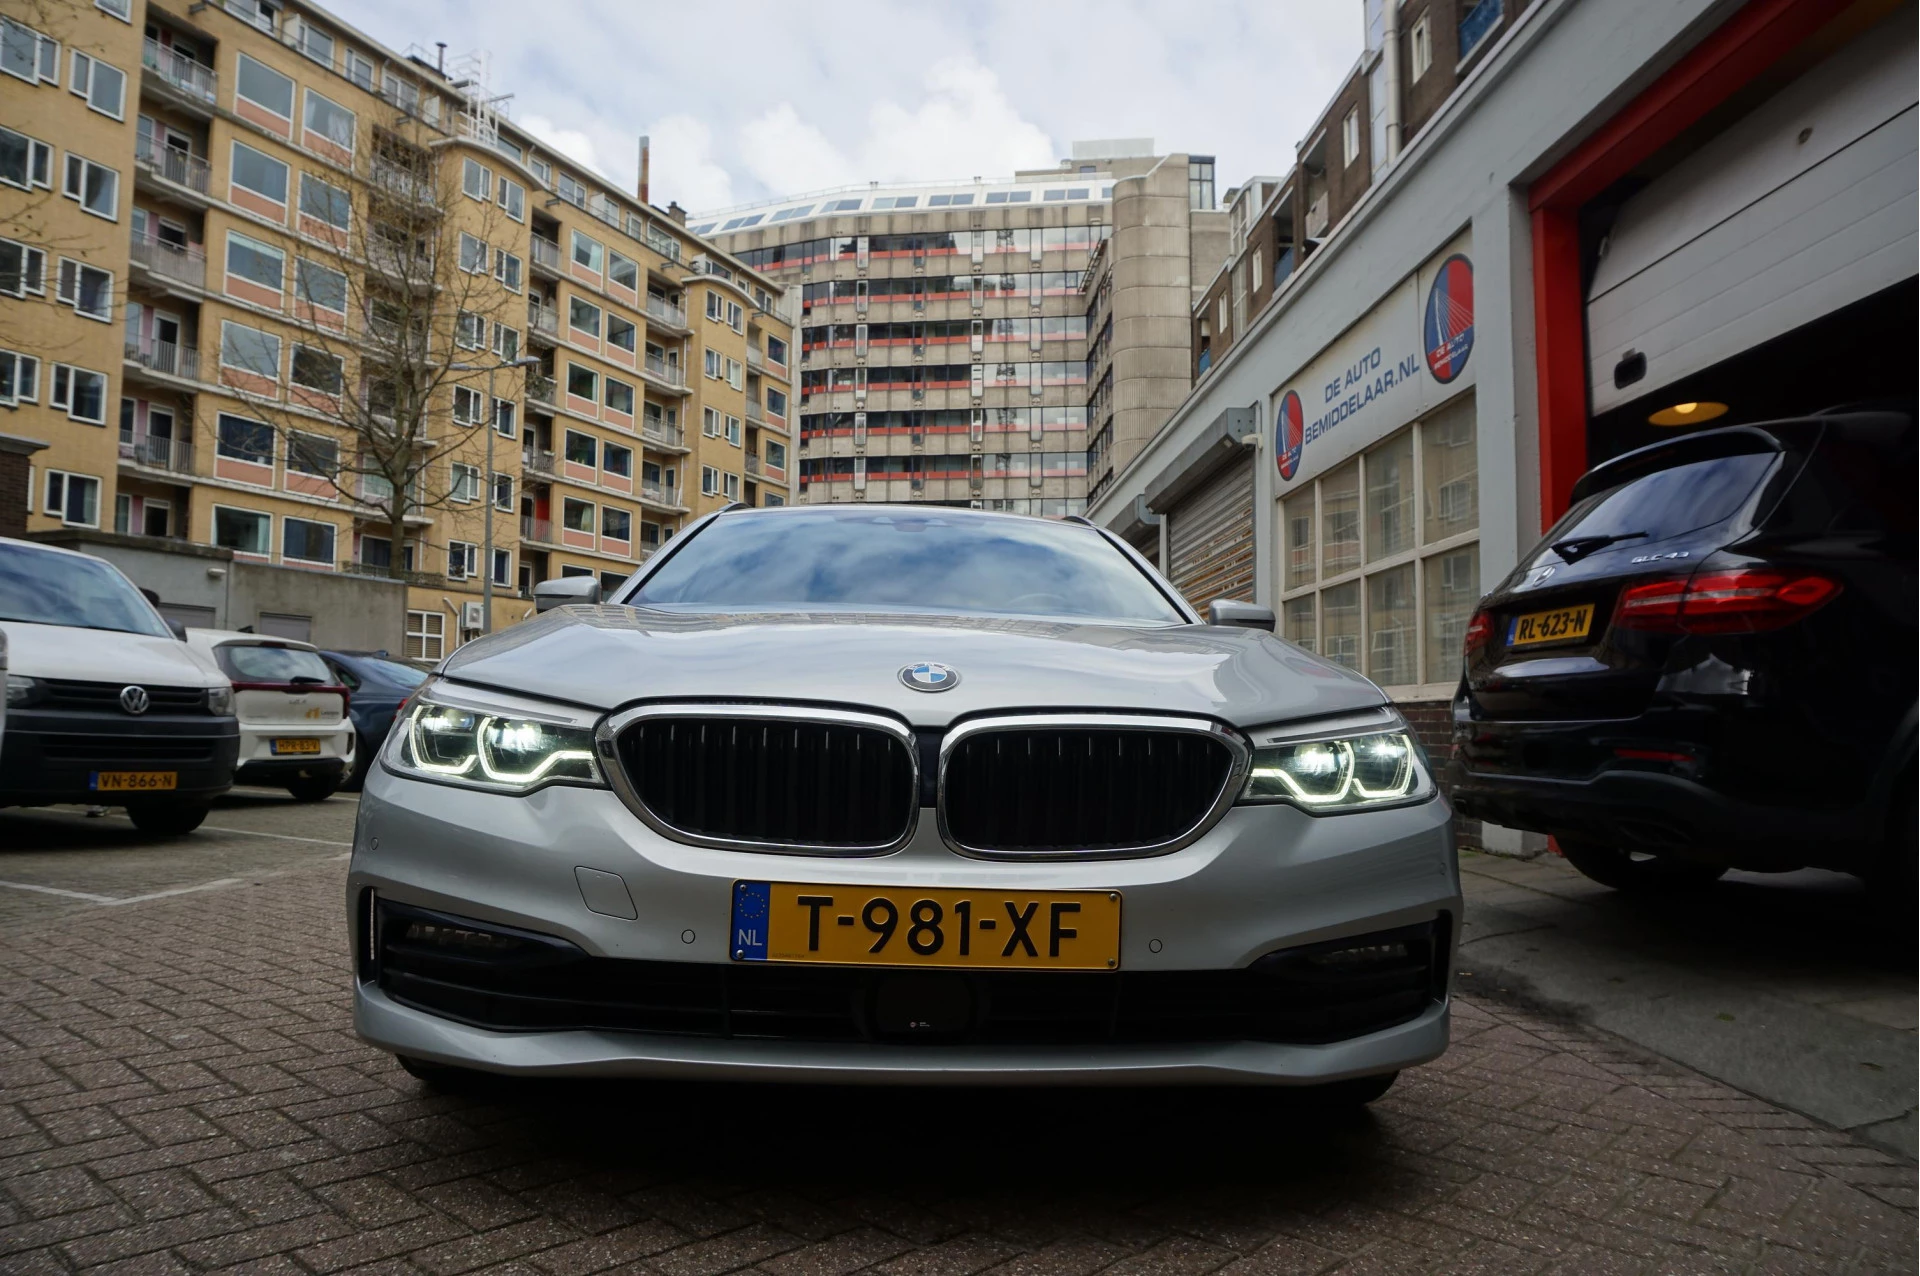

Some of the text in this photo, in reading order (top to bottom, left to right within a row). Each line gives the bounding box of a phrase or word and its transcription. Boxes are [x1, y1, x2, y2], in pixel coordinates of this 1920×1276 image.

[1325, 346, 1381, 403] DE AUTO
[1305, 353, 1420, 445] BEMIDDELAAR.NL
[1631, 551, 1690, 564] GLC 43
[1518, 609, 1588, 641] RL-623-N
[101, 774, 173, 788] VN-866-N
[738, 928, 763, 946] NL
[797, 895, 1081, 958] T-981-XF
